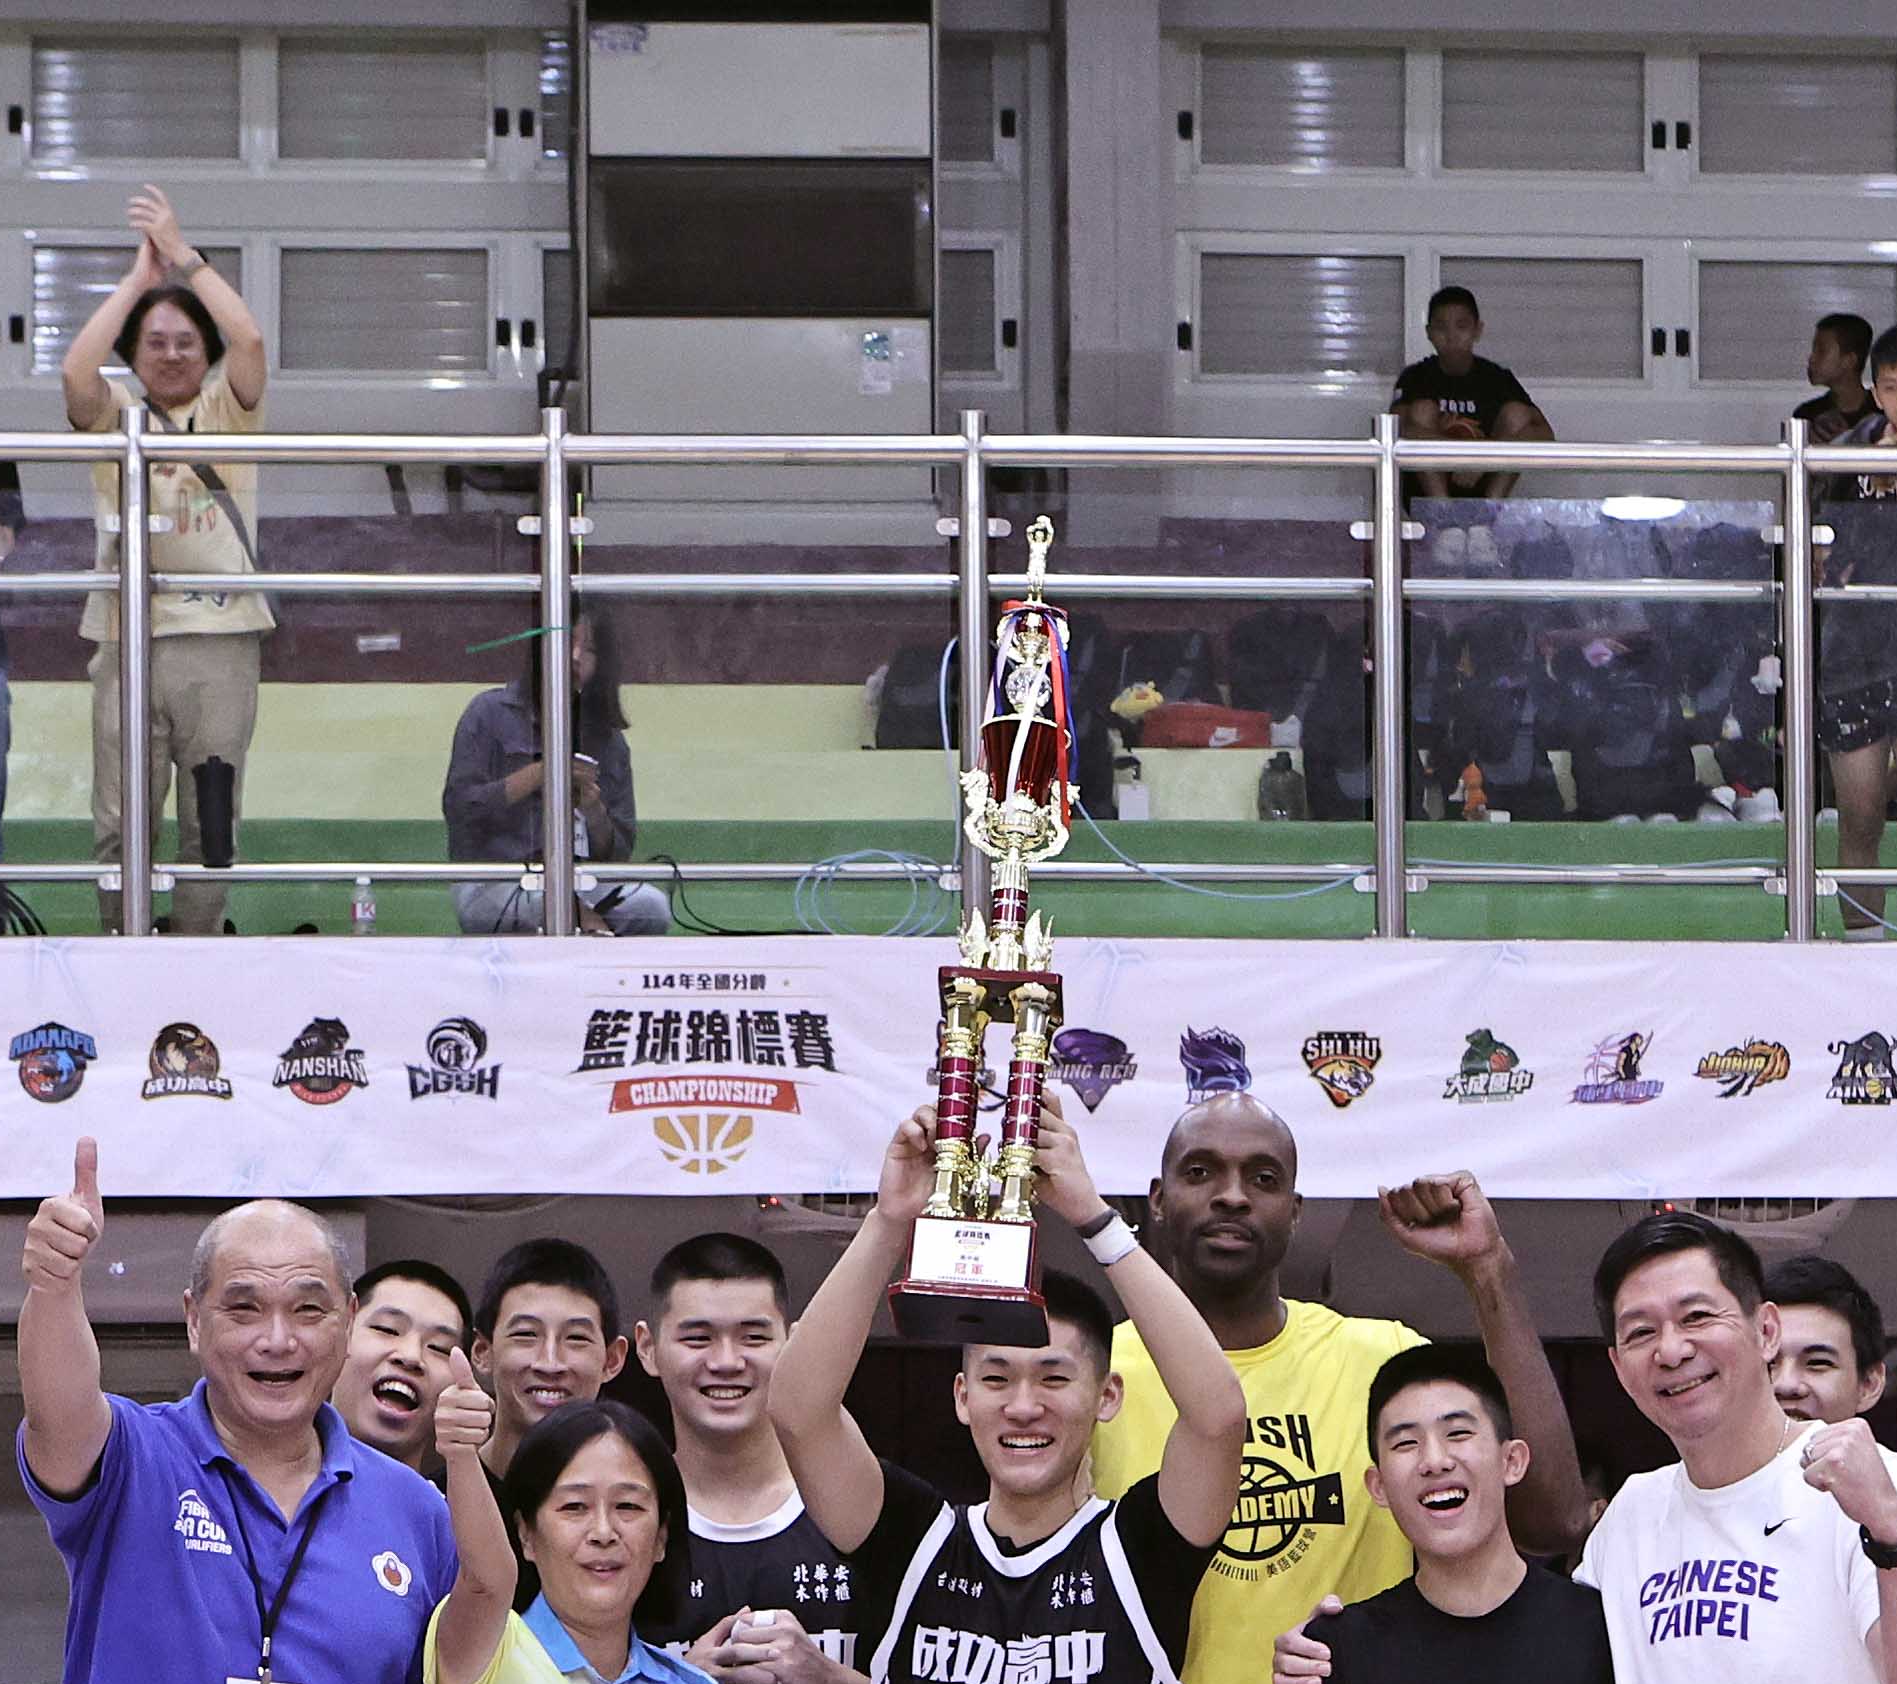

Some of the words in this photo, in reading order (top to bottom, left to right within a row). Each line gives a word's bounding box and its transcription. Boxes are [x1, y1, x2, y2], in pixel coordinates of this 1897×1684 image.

[577, 1009, 838, 1072] 籃球錦標賽
[275, 1056, 367, 1085] NANSHAN
[406, 1065, 502, 1099] CGSH
[629, 1080, 778, 1105] CHAMPIONSHIP
[1247, 1414, 1317, 1474] SH
[1232, 1483, 1317, 1524] DEMY
[185, 1539, 233, 1555] UALIFIERS
[1639, 1559, 1779, 1608] CHINESE
[1650, 1599, 1750, 1645] TAIPEI
